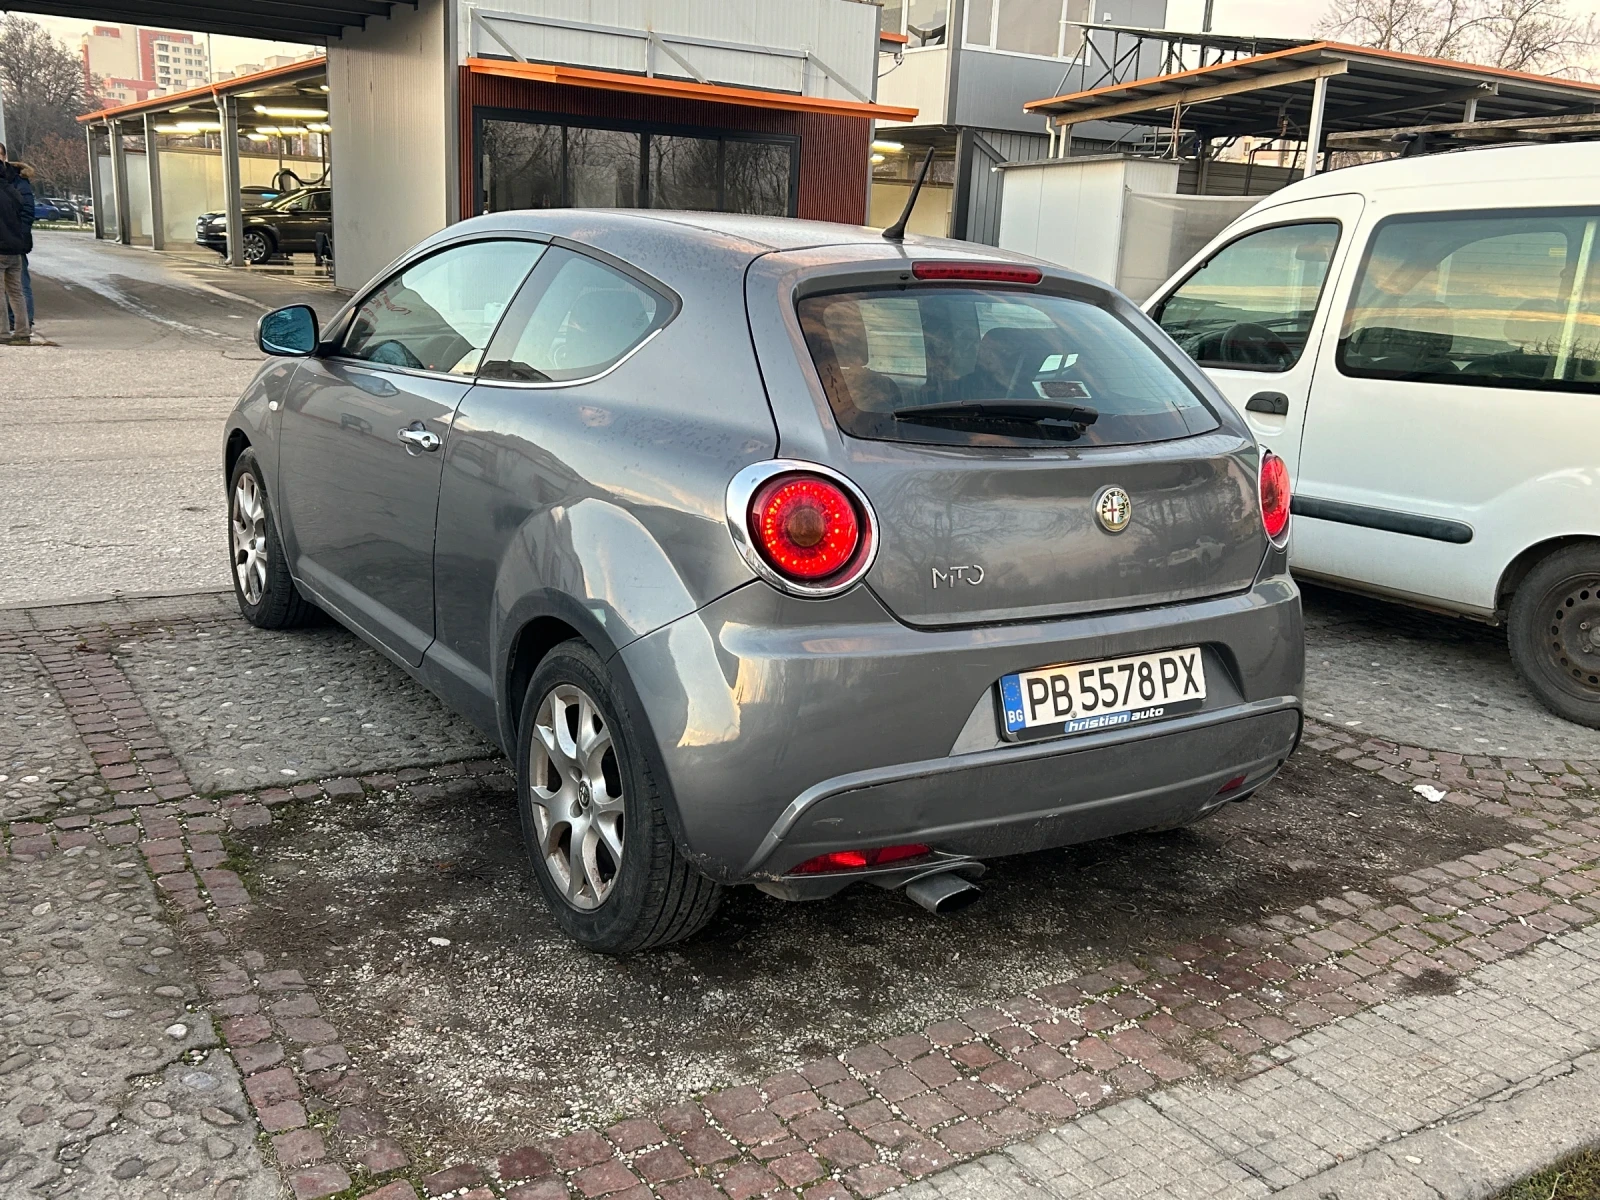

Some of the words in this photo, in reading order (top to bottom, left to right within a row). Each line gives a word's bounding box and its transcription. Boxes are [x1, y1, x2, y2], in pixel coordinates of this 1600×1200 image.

[1026, 674, 1073, 721] PB
[1078, 661, 1156, 711] 5578
[1159, 653, 1200, 699] PX
[1008, 709, 1024, 724] BG
[1131, 707, 1164, 721] auto
